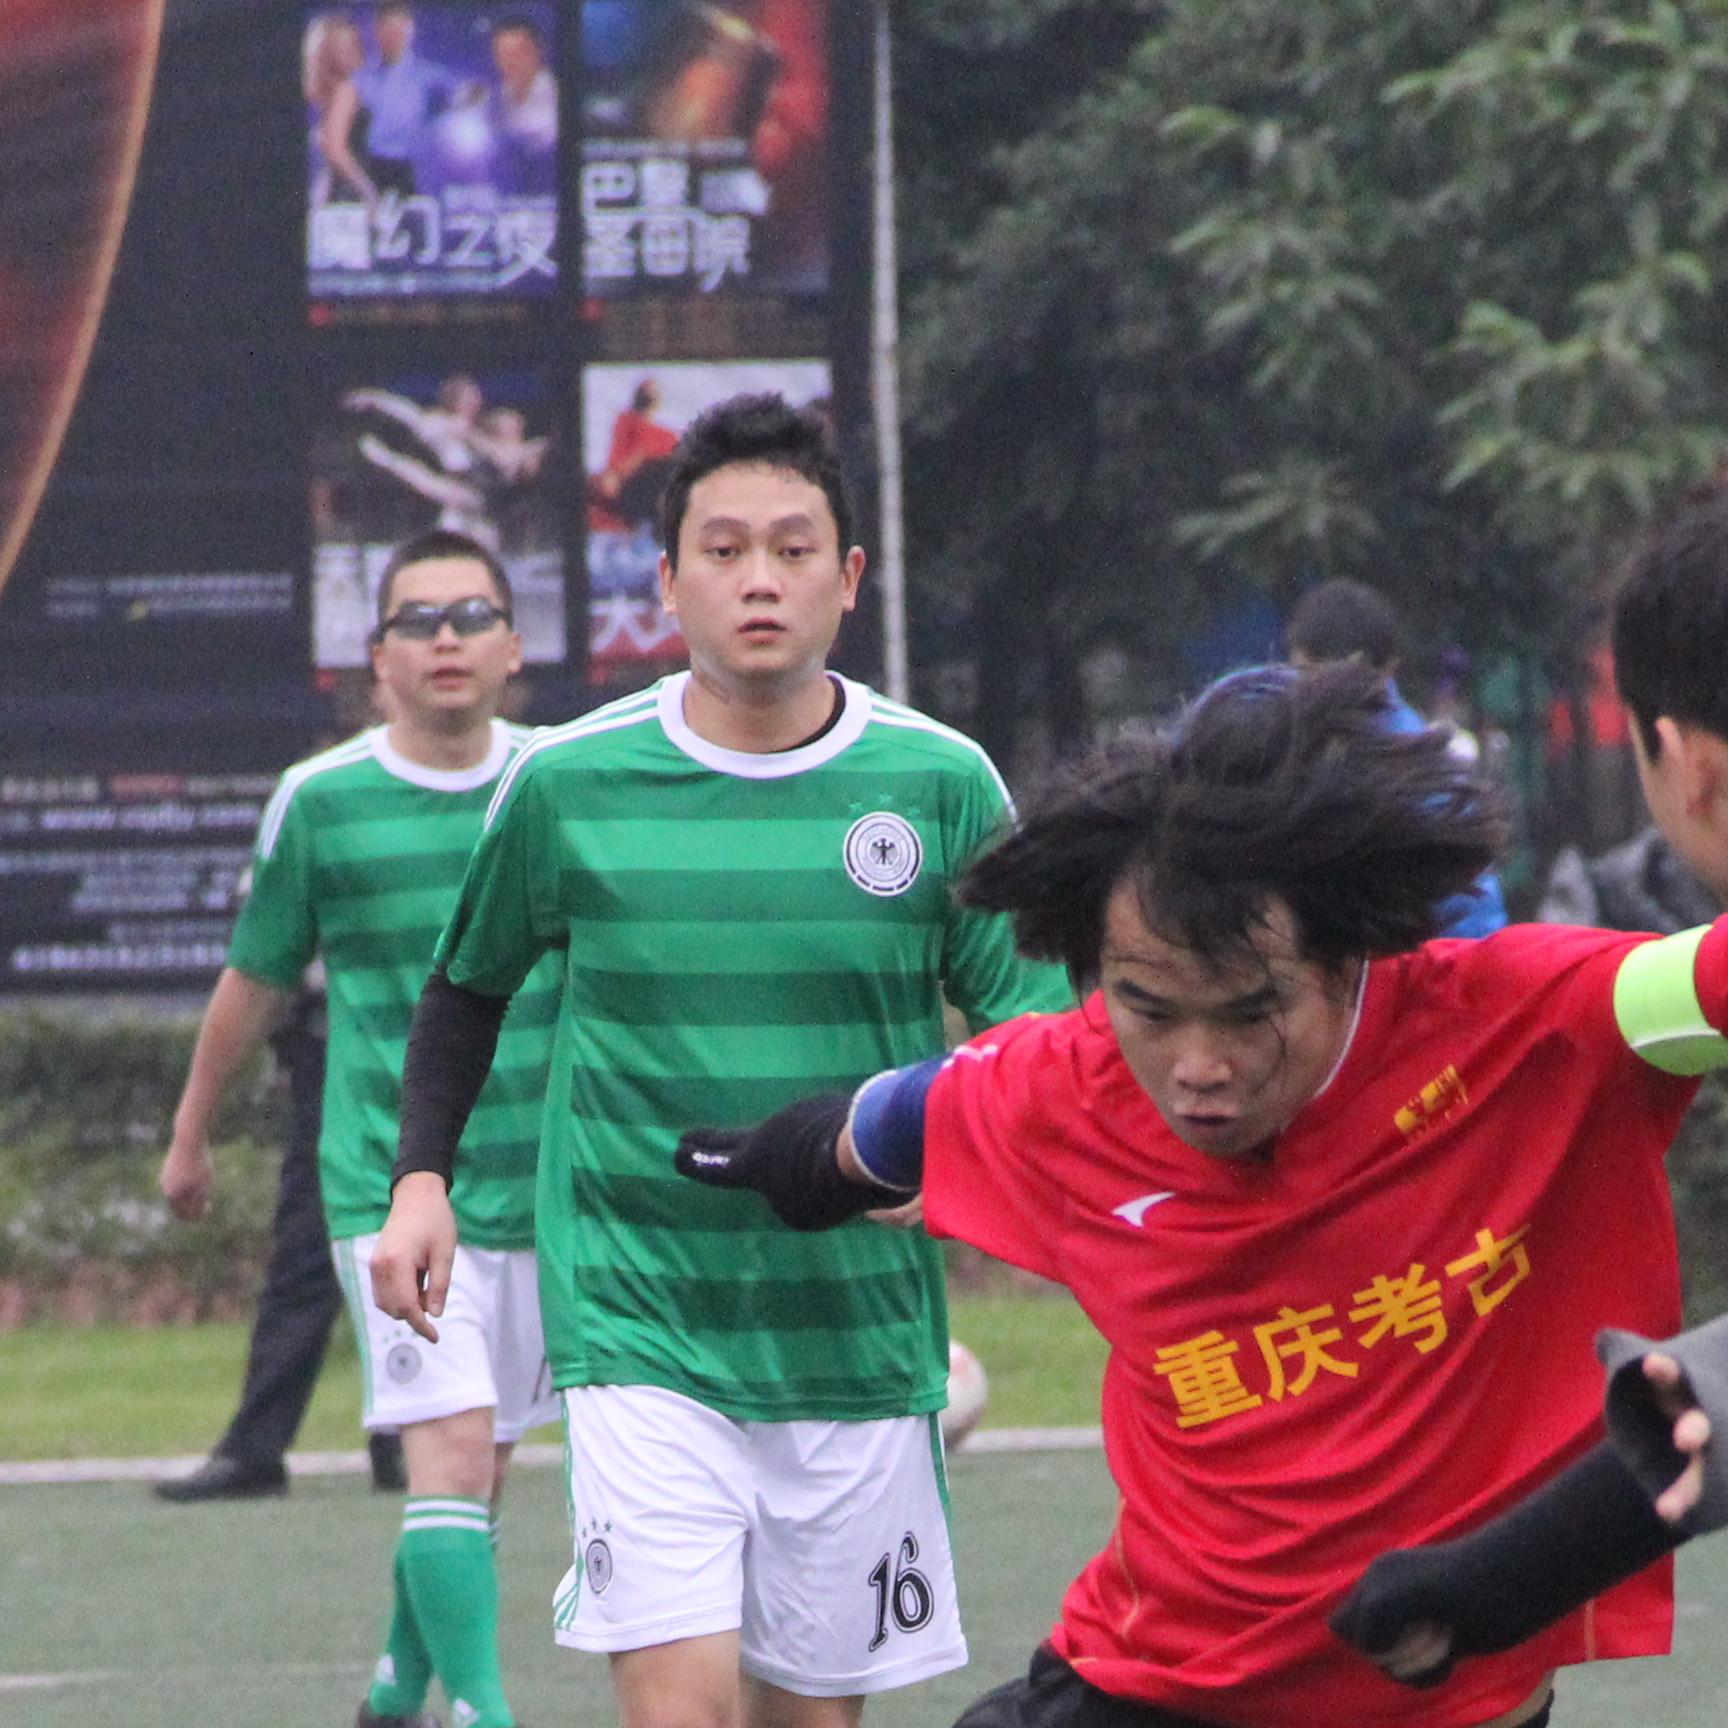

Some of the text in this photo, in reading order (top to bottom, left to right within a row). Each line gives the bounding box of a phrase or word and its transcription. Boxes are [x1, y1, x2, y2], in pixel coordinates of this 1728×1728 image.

[1152, 1222, 1533, 1430] 重庆考古
[868, 1530, 935, 1652] 16
